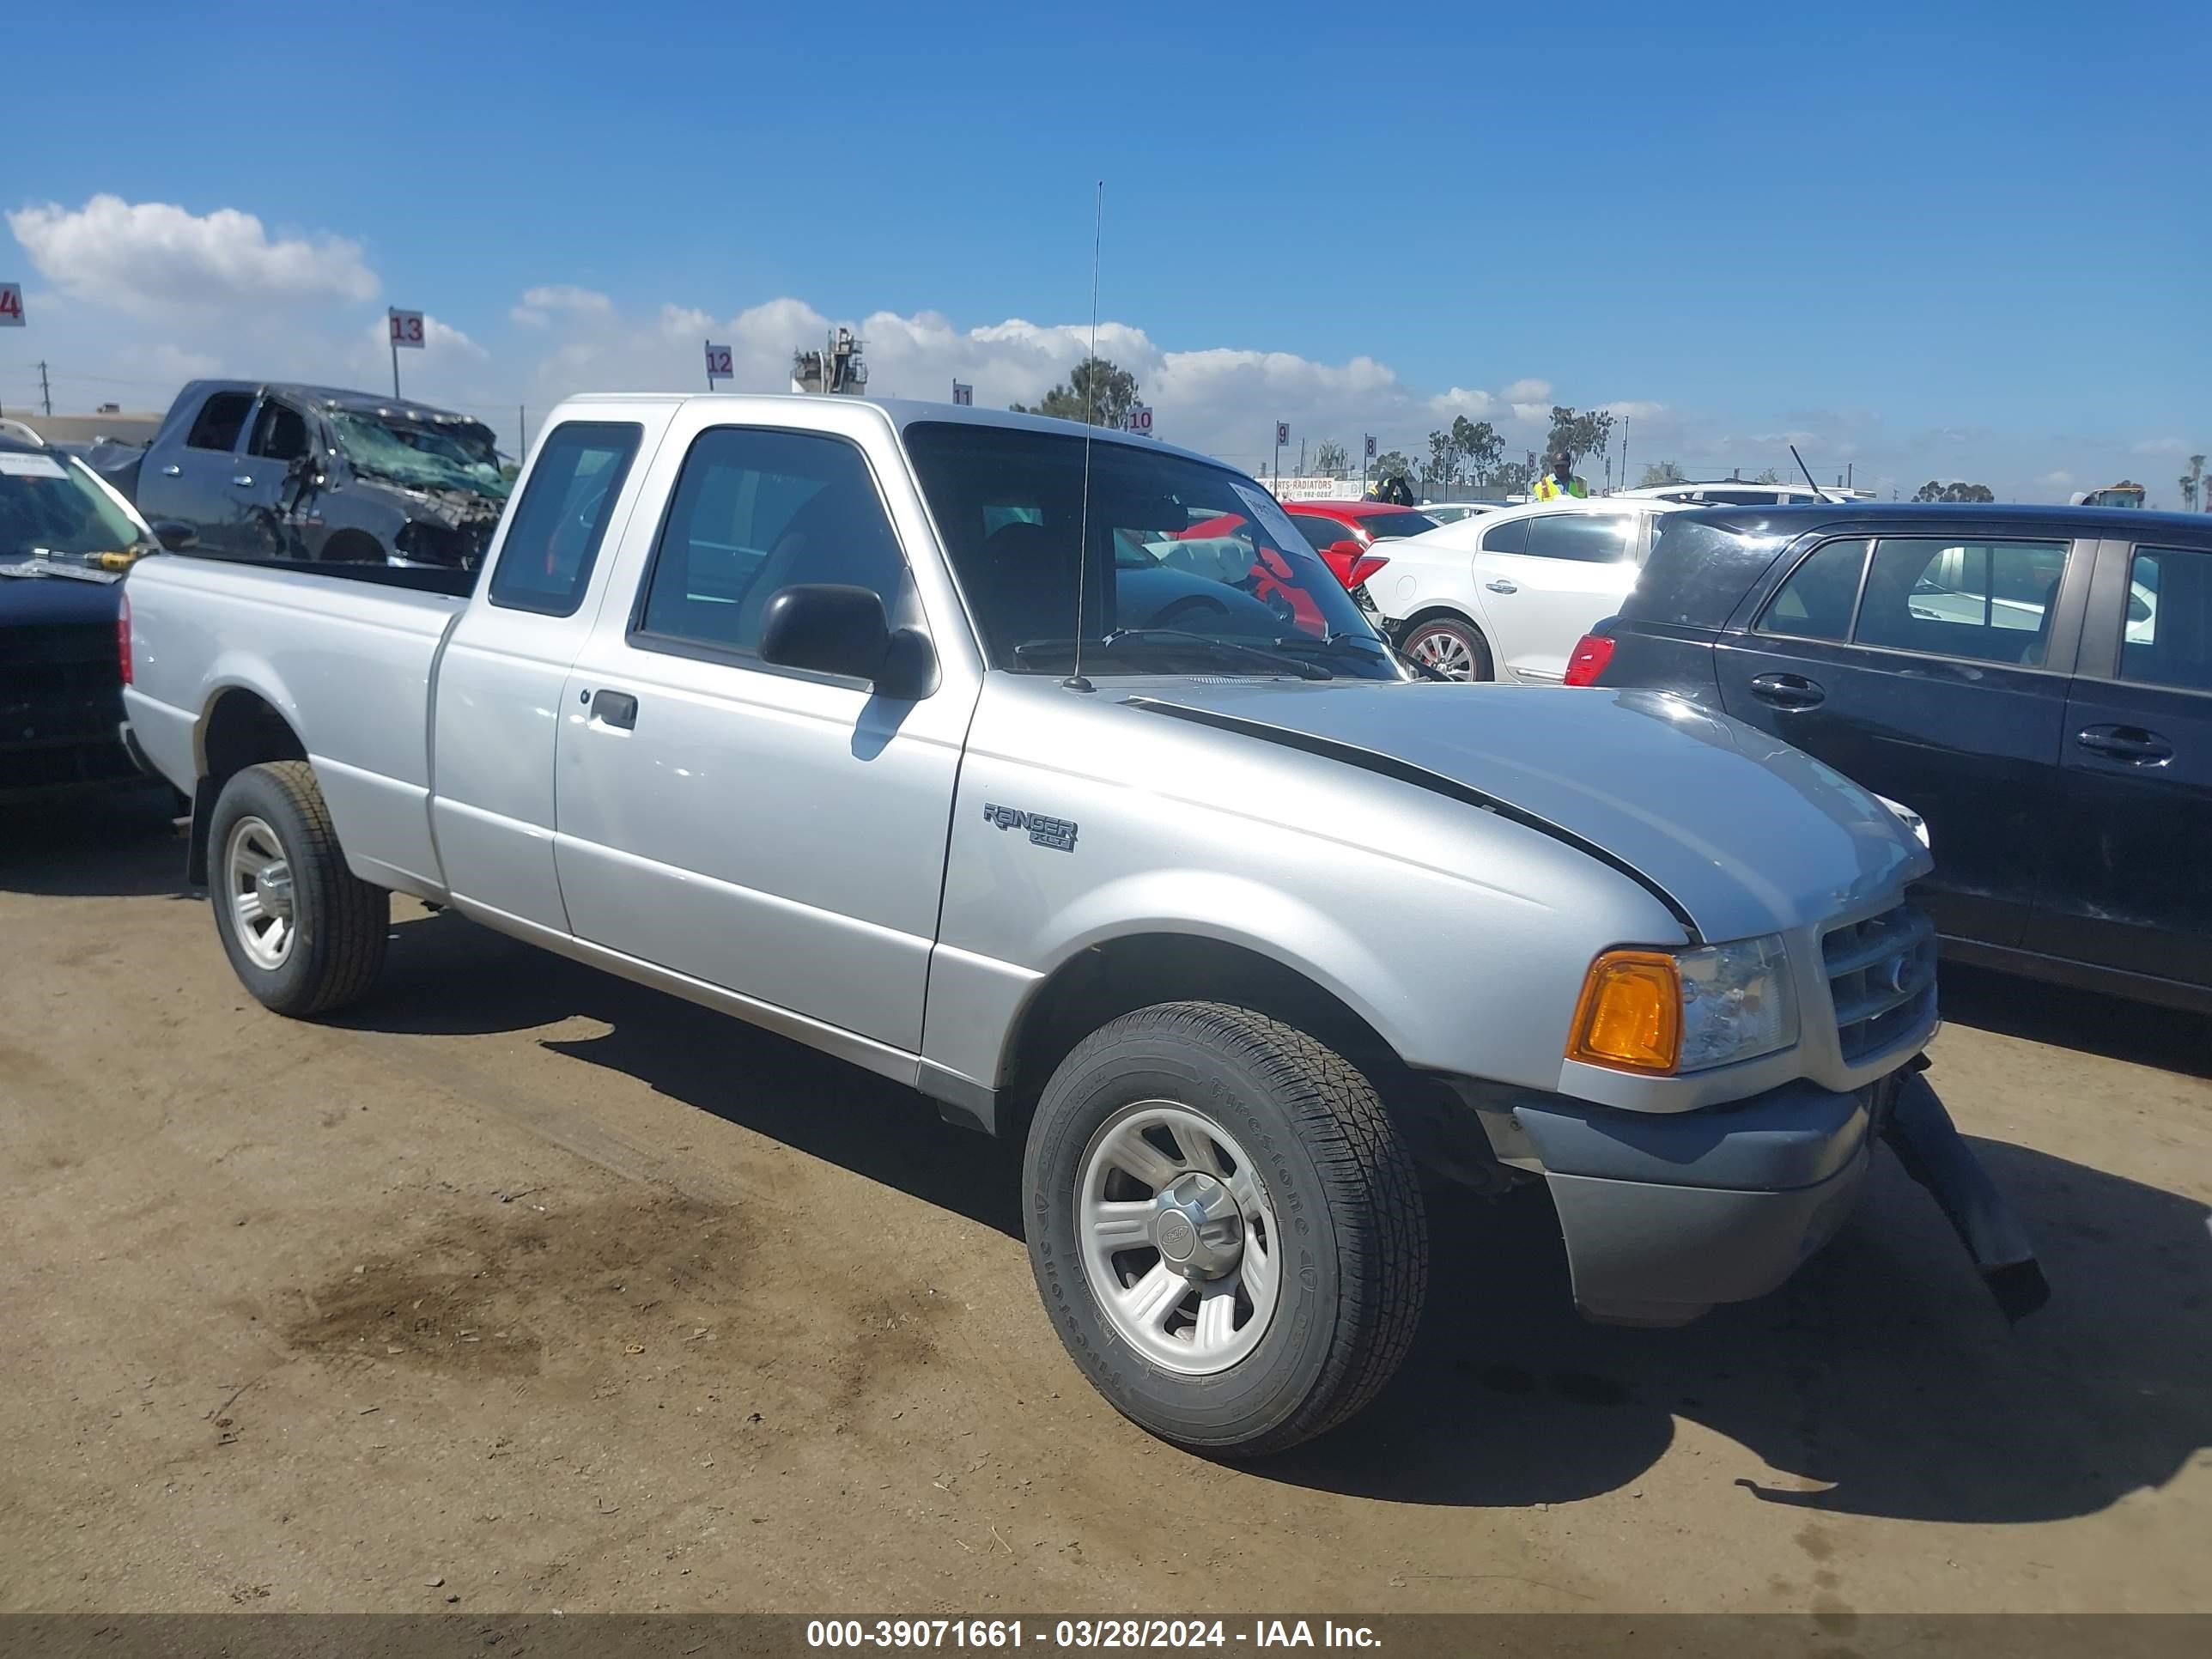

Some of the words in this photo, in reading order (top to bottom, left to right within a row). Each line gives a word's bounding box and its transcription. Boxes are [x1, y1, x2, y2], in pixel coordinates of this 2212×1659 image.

[392, 317, 422, 341] 13
[706, 352, 732, 373] 12
[954, 389, 969, 405] 11
[1129, 412, 1152, 428] 10
[1279, 425, 1286, 444] 9
[1367, 439, 1374, 455] 8
[1448, 447, 1455, 461] 7
[1528, 453, 1534, 468] 6
[1268, 480, 1333, 490] PRTS-RADIATORS
[983, 802, 1079, 842] RANGER
